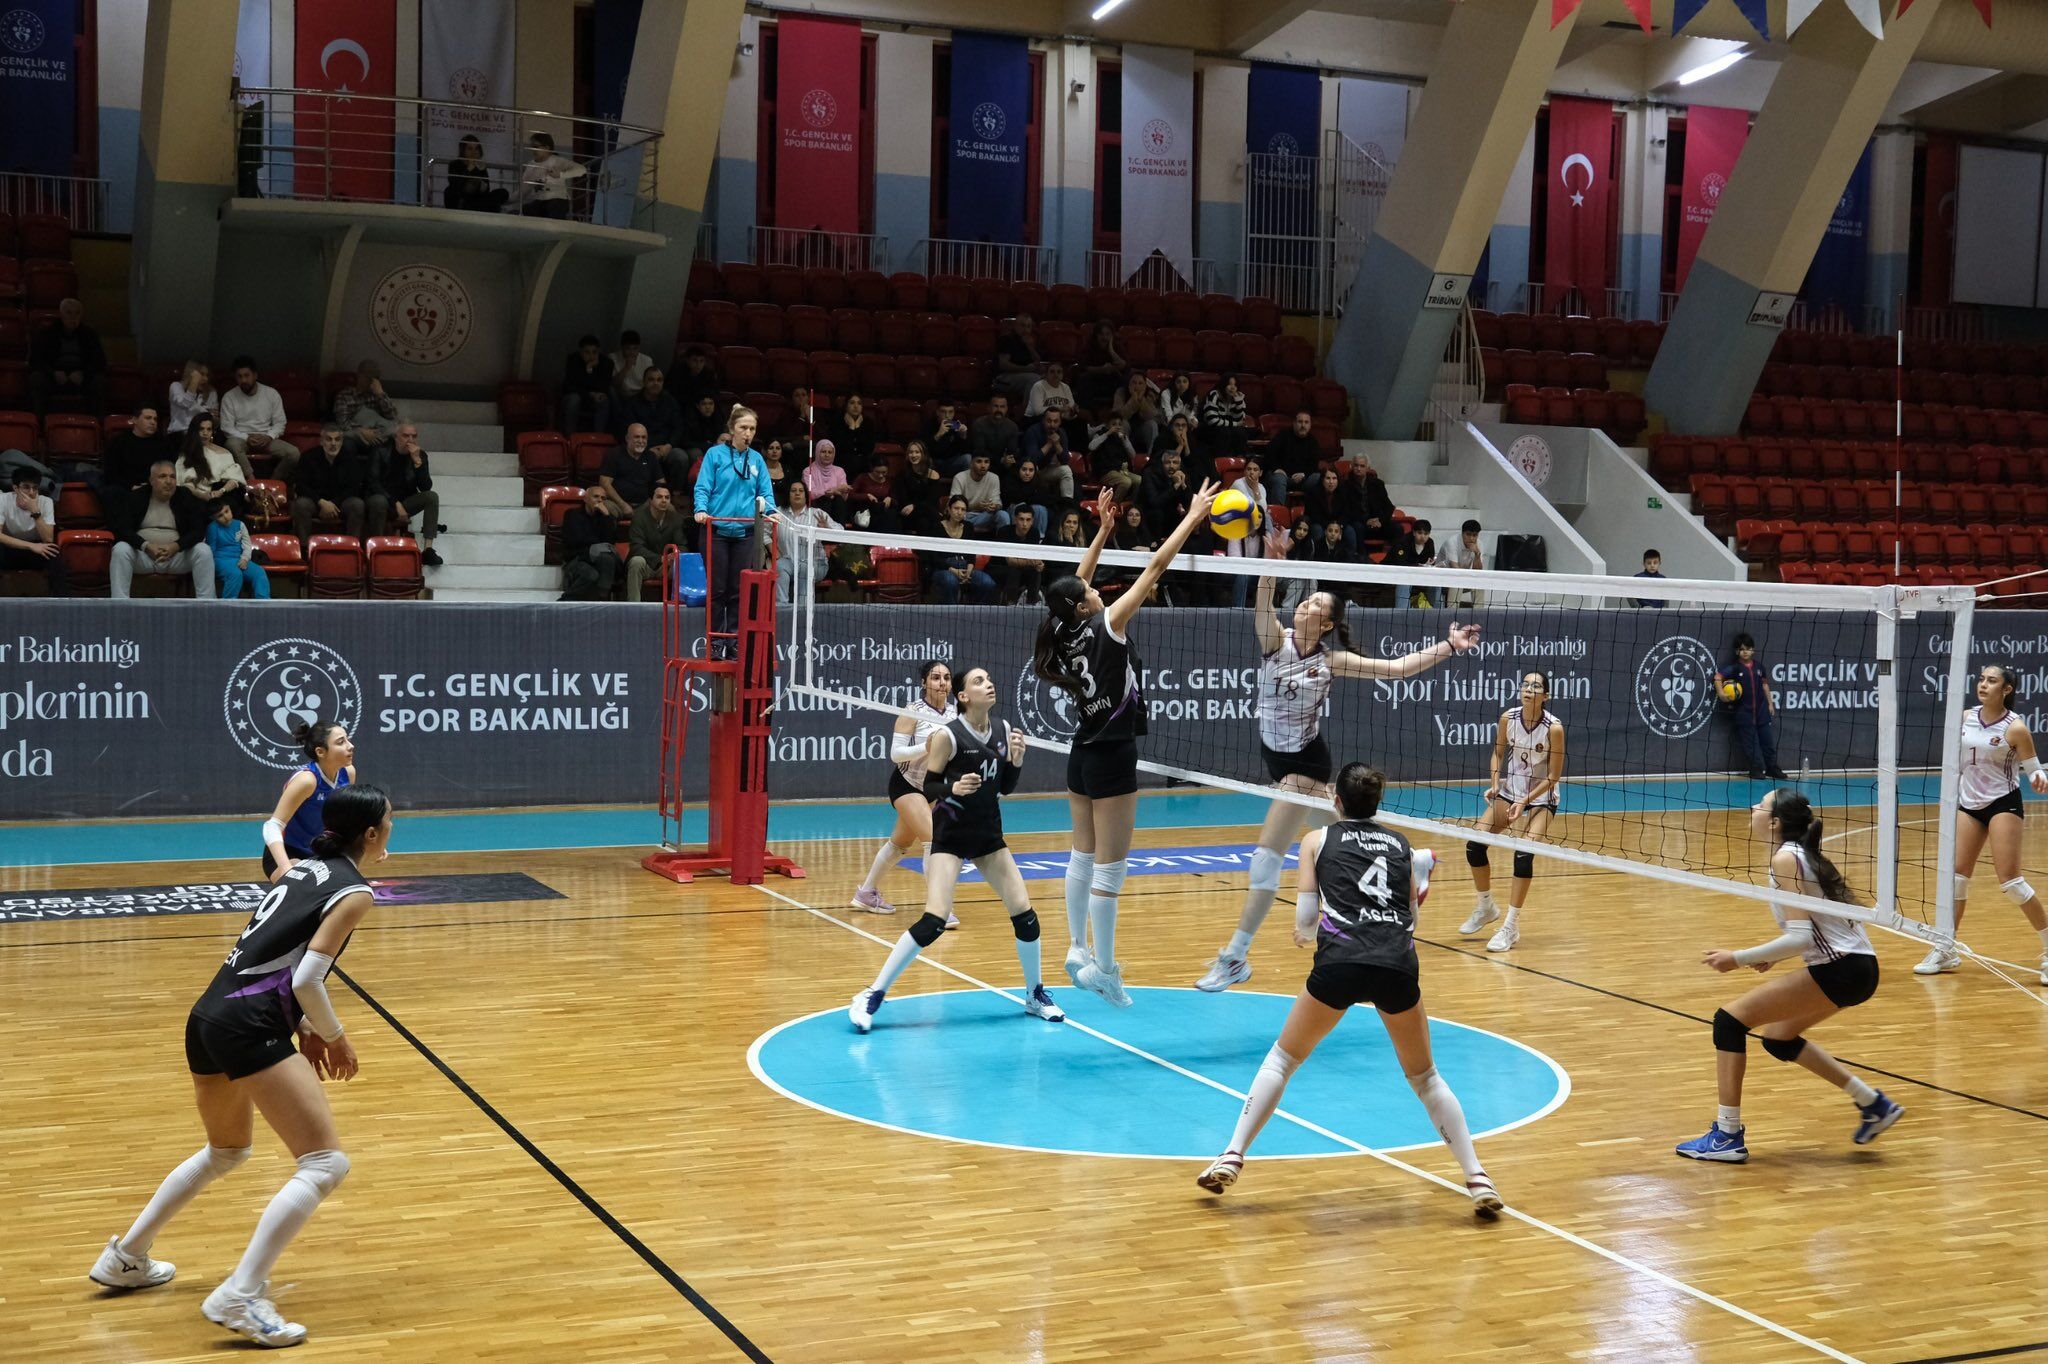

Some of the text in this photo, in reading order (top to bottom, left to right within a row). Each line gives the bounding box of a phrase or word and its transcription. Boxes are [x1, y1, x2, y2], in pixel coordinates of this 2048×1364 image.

[52, 60, 66, 70] VE
[784, 128, 853, 142] T.C. GENÇLİK VE
[784, 138, 853, 152] SPOR BAKANLIĞI
[956, 139, 1020, 153] T.C. GENÇLİK VE
[956, 149, 1020, 163] SPOR BAKANLIĞI
[1128, 157, 1142, 165] T.C.
[1143, 158, 1175, 168] GENÇLİK
[1128, 167, 1188, 177] SPOR BAKANLIĞI
[1444, 280, 1454, 290] G
[1770, 299, 1780, 308] F
[1461, 405, 1467, 415] E
[19, 636, 140, 668] Bakanlığı
[862, 637, 953, 661] Bakanlığı
[1513, 636, 1587, 660] Bakanlığı
[2000, 635, 2035, 659] Spor
[379, 668, 628, 702] T.C. GENÇLİK VE
[1071, 655, 1097, 698] 3
[1772, 659, 1880, 687] GENÇLİK V
[1273, 676, 1299, 701] 18
[1373, 670, 1591, 710] Spor Kulüplinin
[1786, 686, 1879, 710] BAKANLIĞ
[0, 680, 150, 729] plerinin
[1144, 699, 1199, 721] POR
[379, 702, 629, 732] SPOR BAKANLIĞI
[768, 726, 887, 762] Yanında
[1969, 746, 1977, 766] 1
[1, 739, 53, 777] da
[979, 758, 998, 782] 14
[1357, 855, 1393, 908] 4
[241, 884, 289, 940] 9
